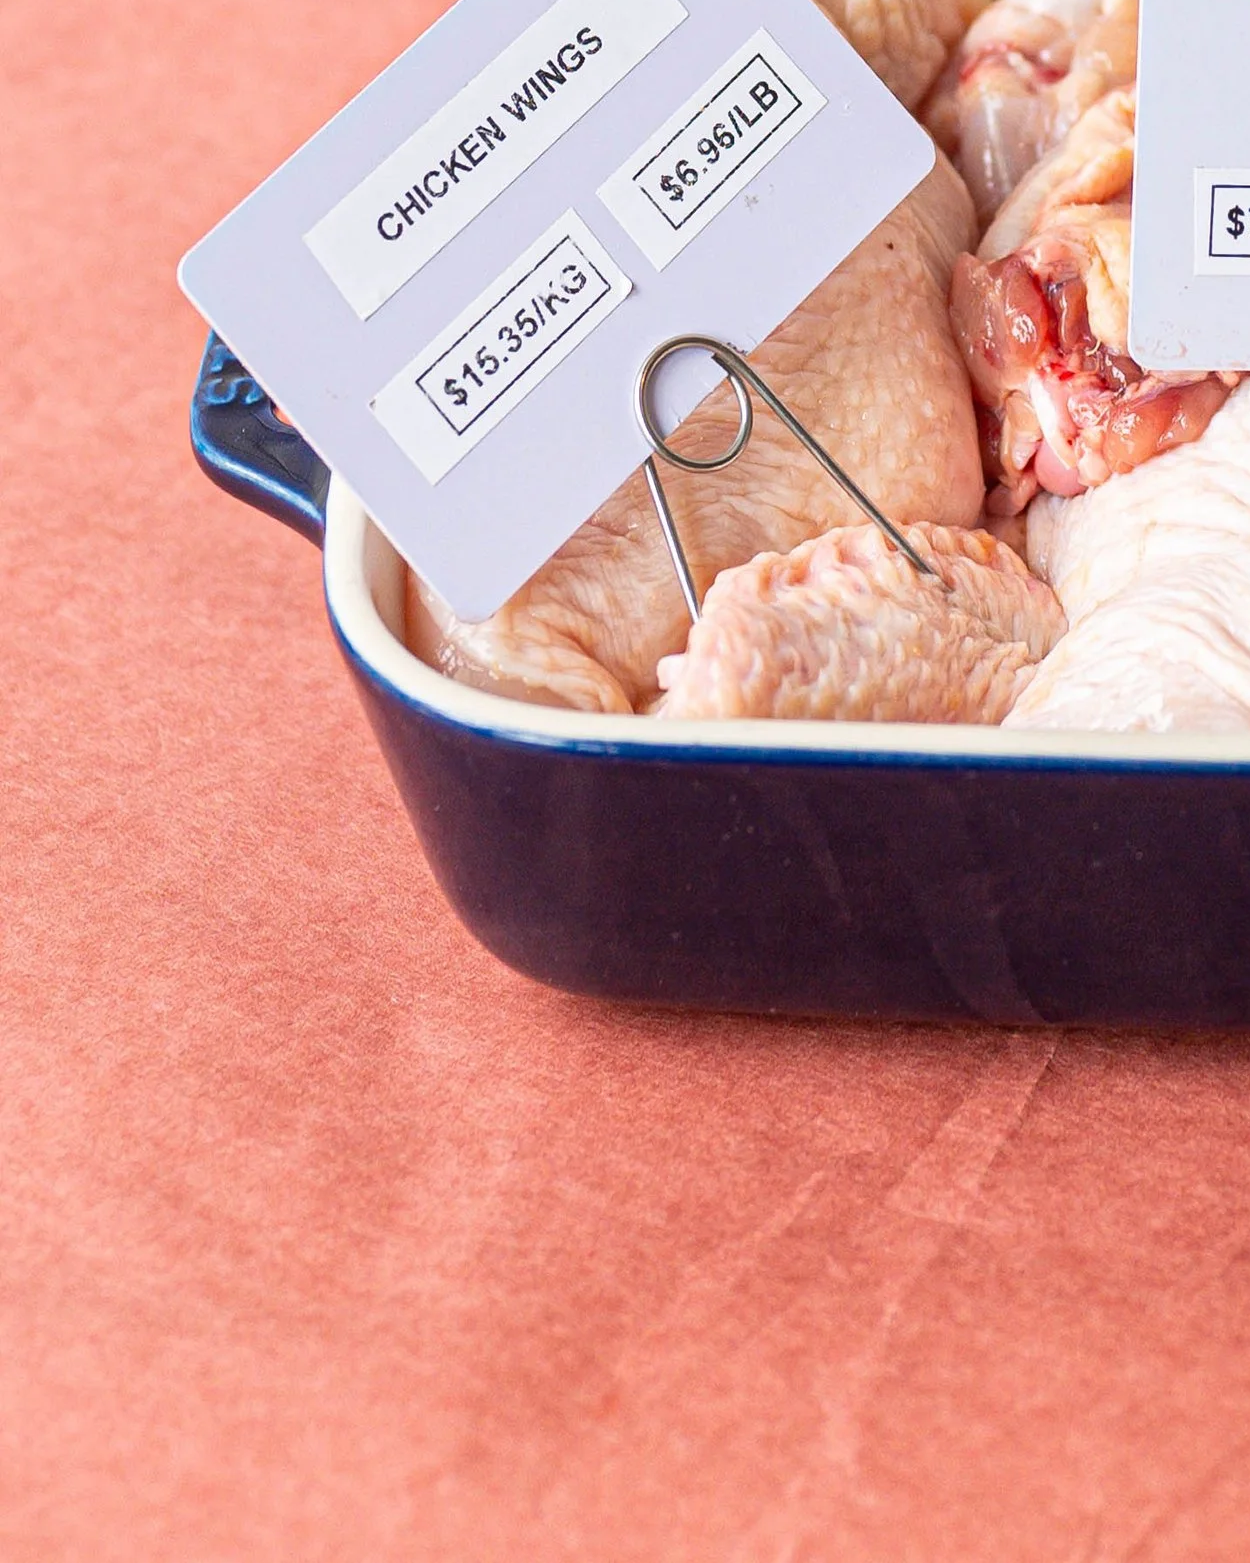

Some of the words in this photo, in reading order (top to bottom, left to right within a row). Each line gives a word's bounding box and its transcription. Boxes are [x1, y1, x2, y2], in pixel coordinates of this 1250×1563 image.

[377, 115, 507, 241] CHICKEN
[500, 26, 603, 122] WINGS
[659, 80, 779, 202] $6.96/LB
[443, 264, 587, 406] $15.35/KG
